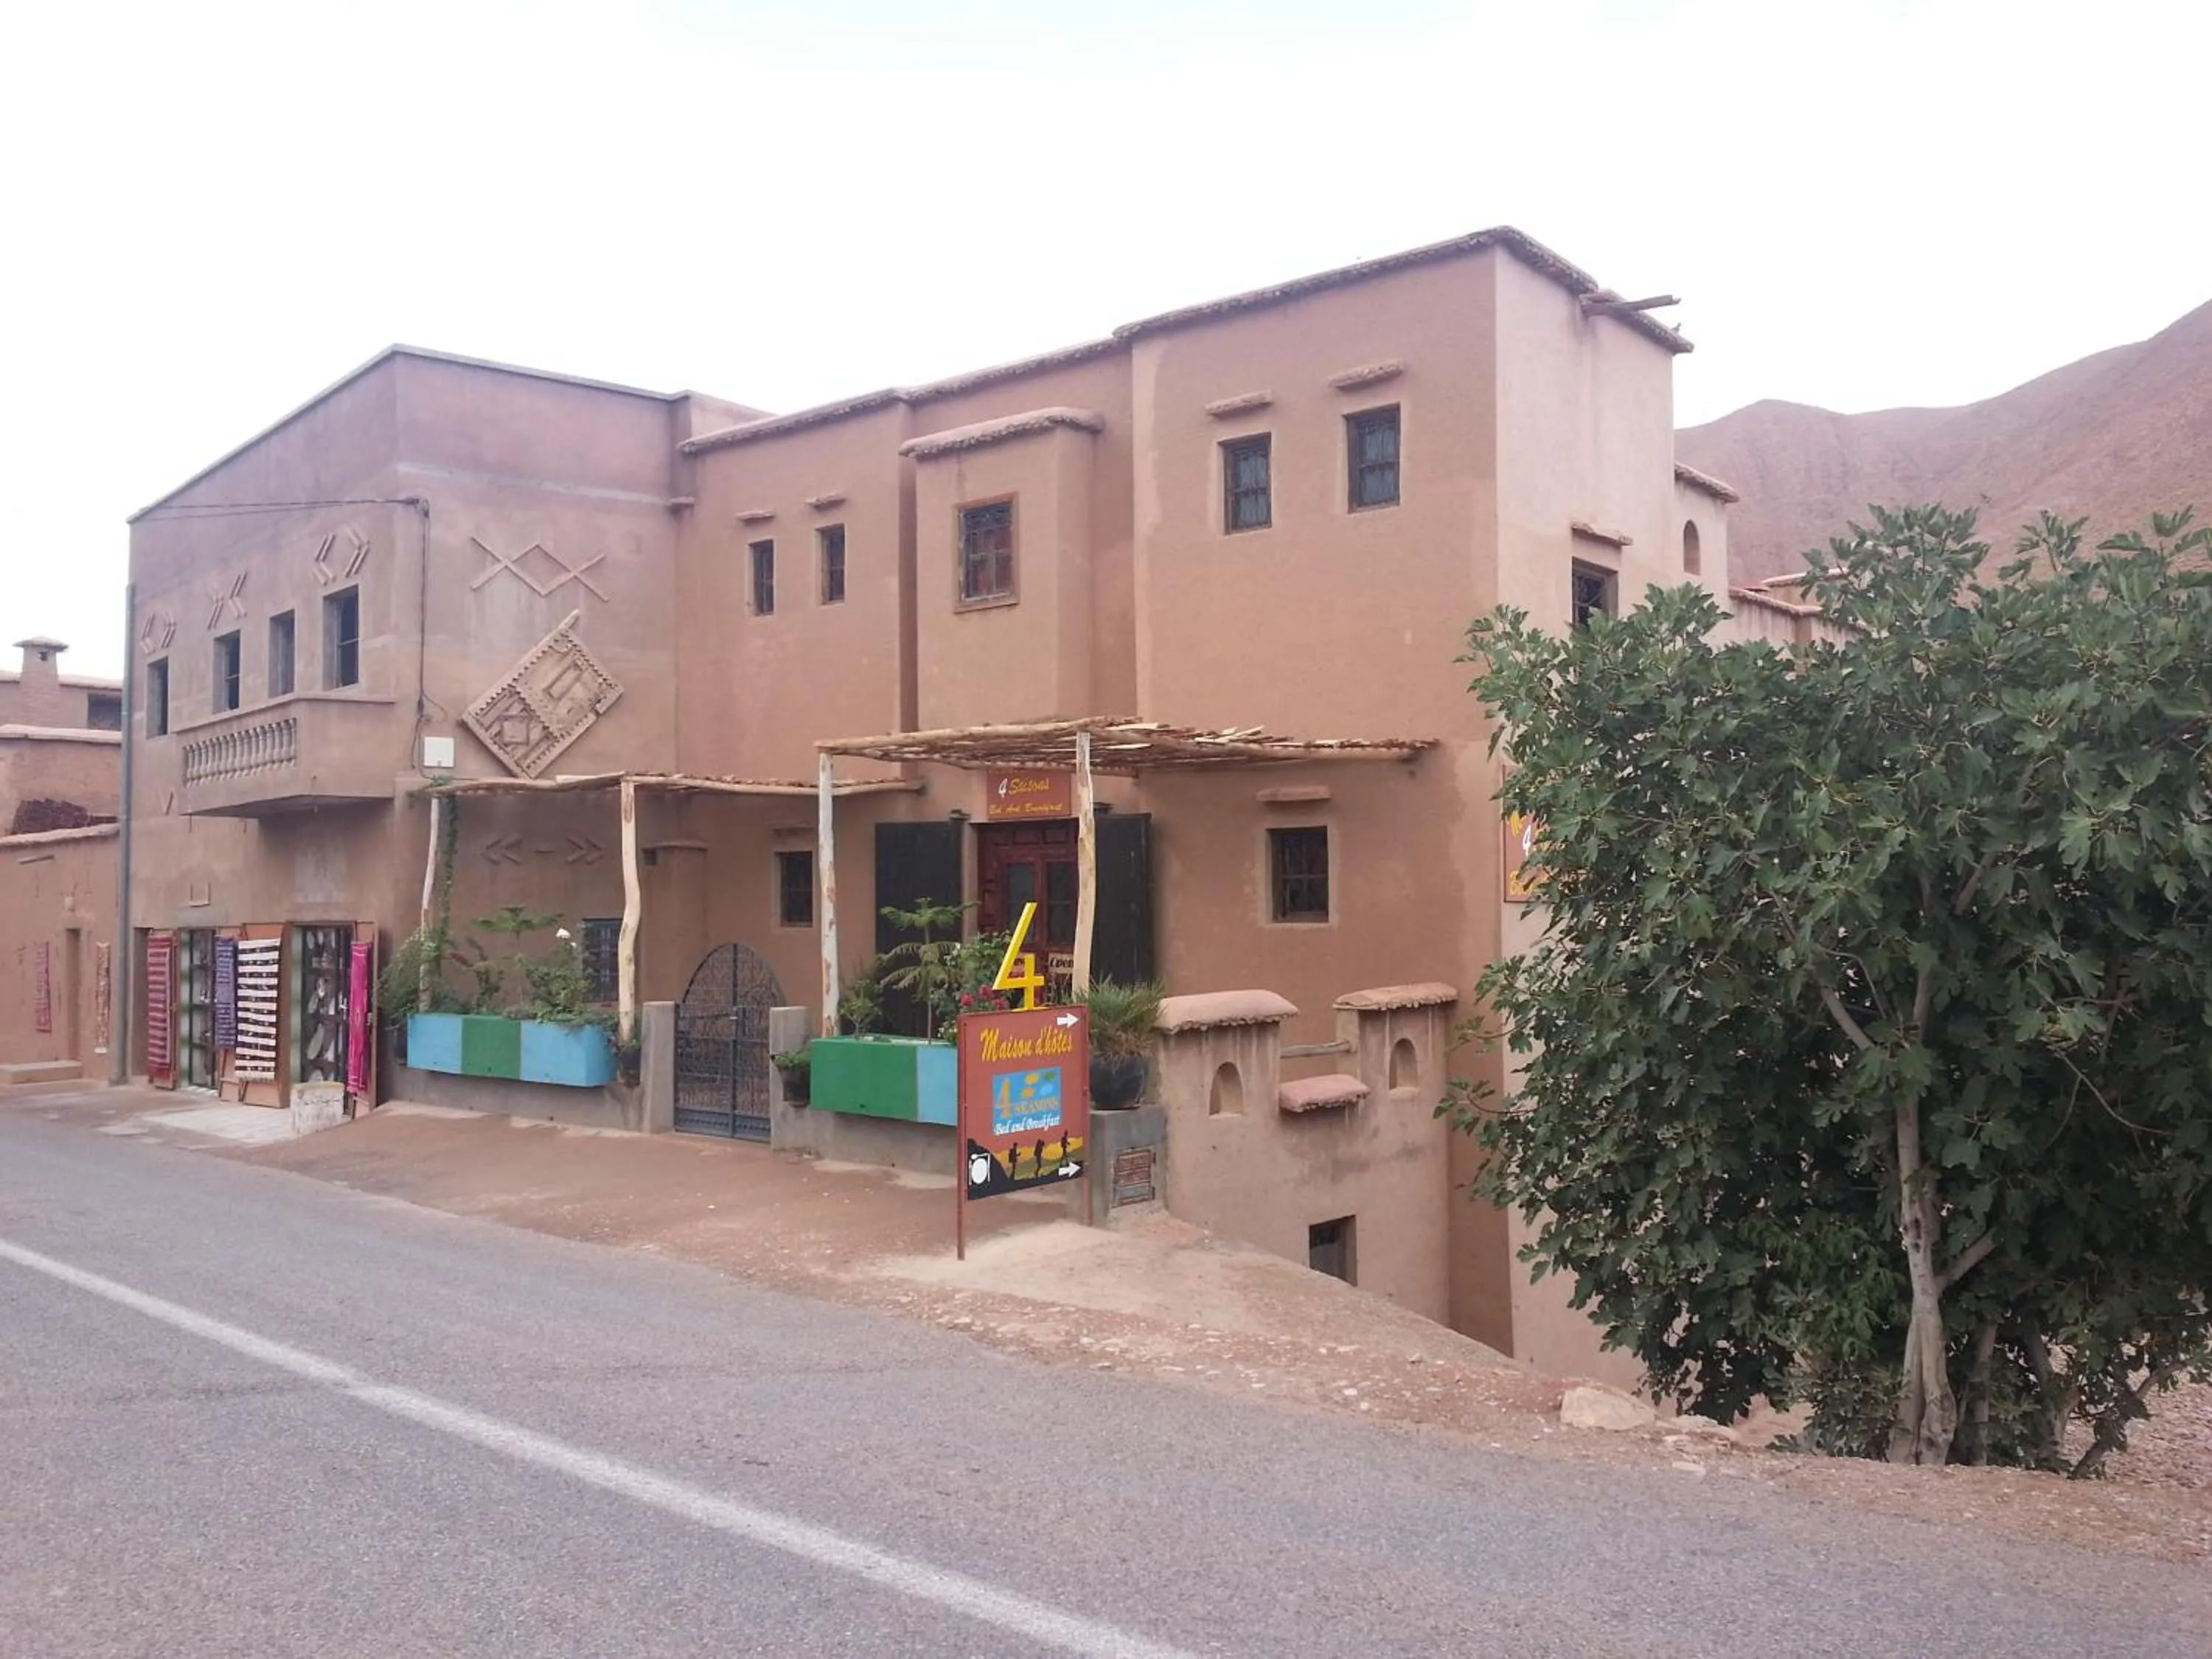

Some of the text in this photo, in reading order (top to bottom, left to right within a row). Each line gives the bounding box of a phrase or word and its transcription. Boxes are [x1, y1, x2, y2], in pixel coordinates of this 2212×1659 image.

[998, 778, 1008, 798] 4
[992, 902, 1045, 1011] 4
[980, 1025, 1072, 1062] Maison d'hôtes
[995, 1077, 1010, 1119] 4
[993, 1113, 1060, 1135] Bed and Breakfast
